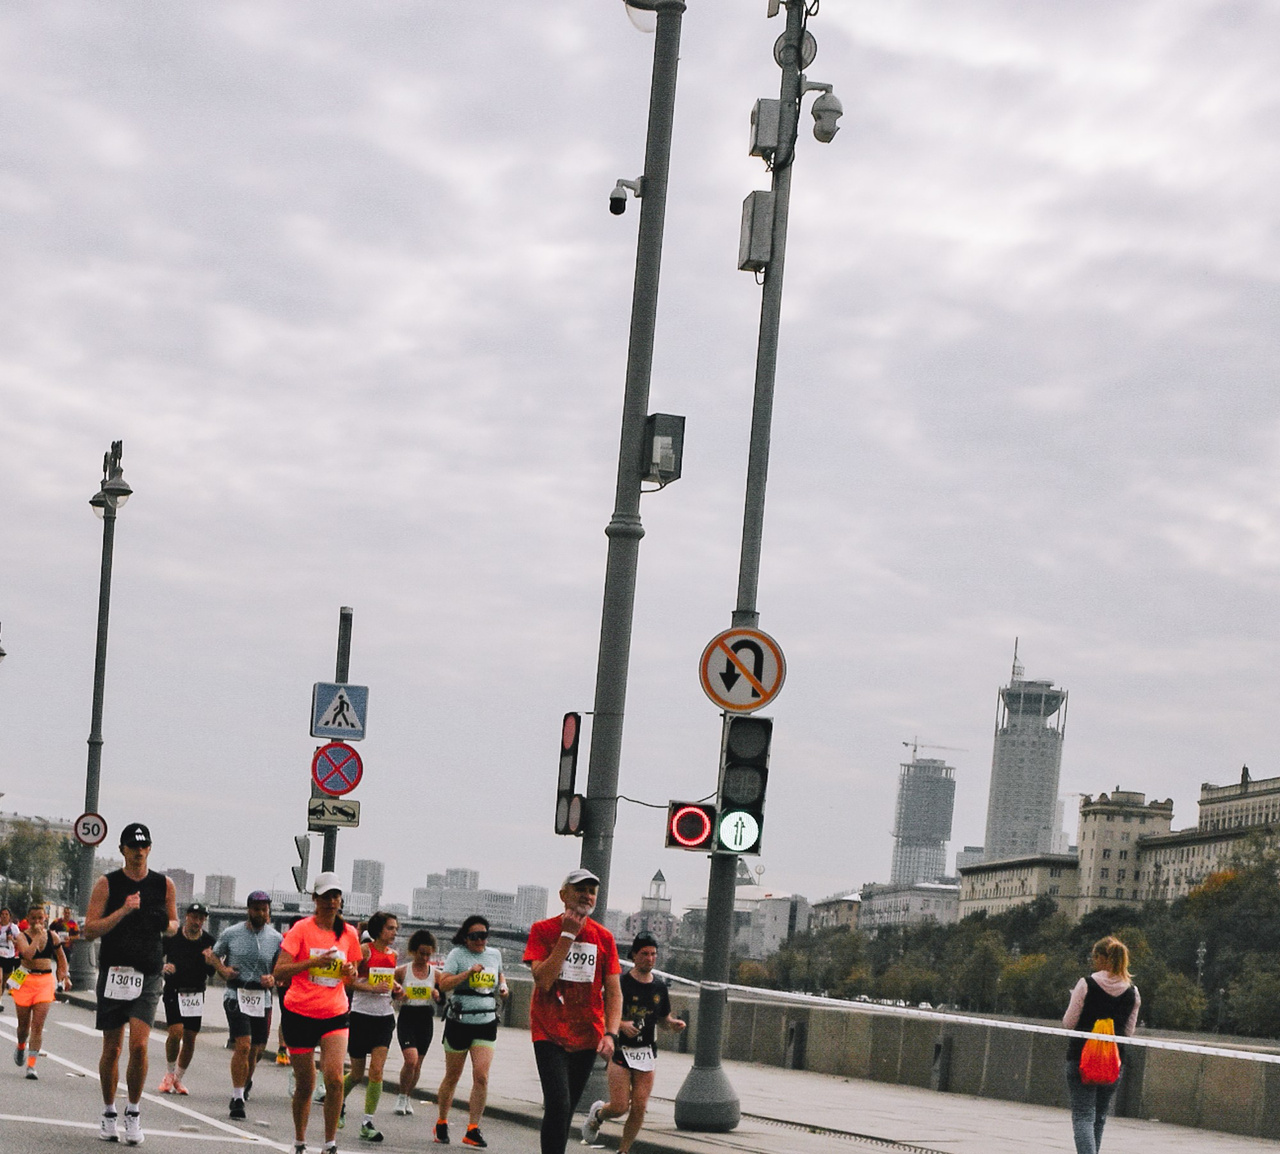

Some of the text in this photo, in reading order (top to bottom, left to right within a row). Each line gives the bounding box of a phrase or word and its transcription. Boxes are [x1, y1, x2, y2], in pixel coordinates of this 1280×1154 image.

[82, 822, 100, 836] 50
[565, 952, 595, 966] 4998
[111, 973, 142, 988] 13018
[181, 999, 200, 1007] 5246
[241, 996, 261, 1005] 5957
